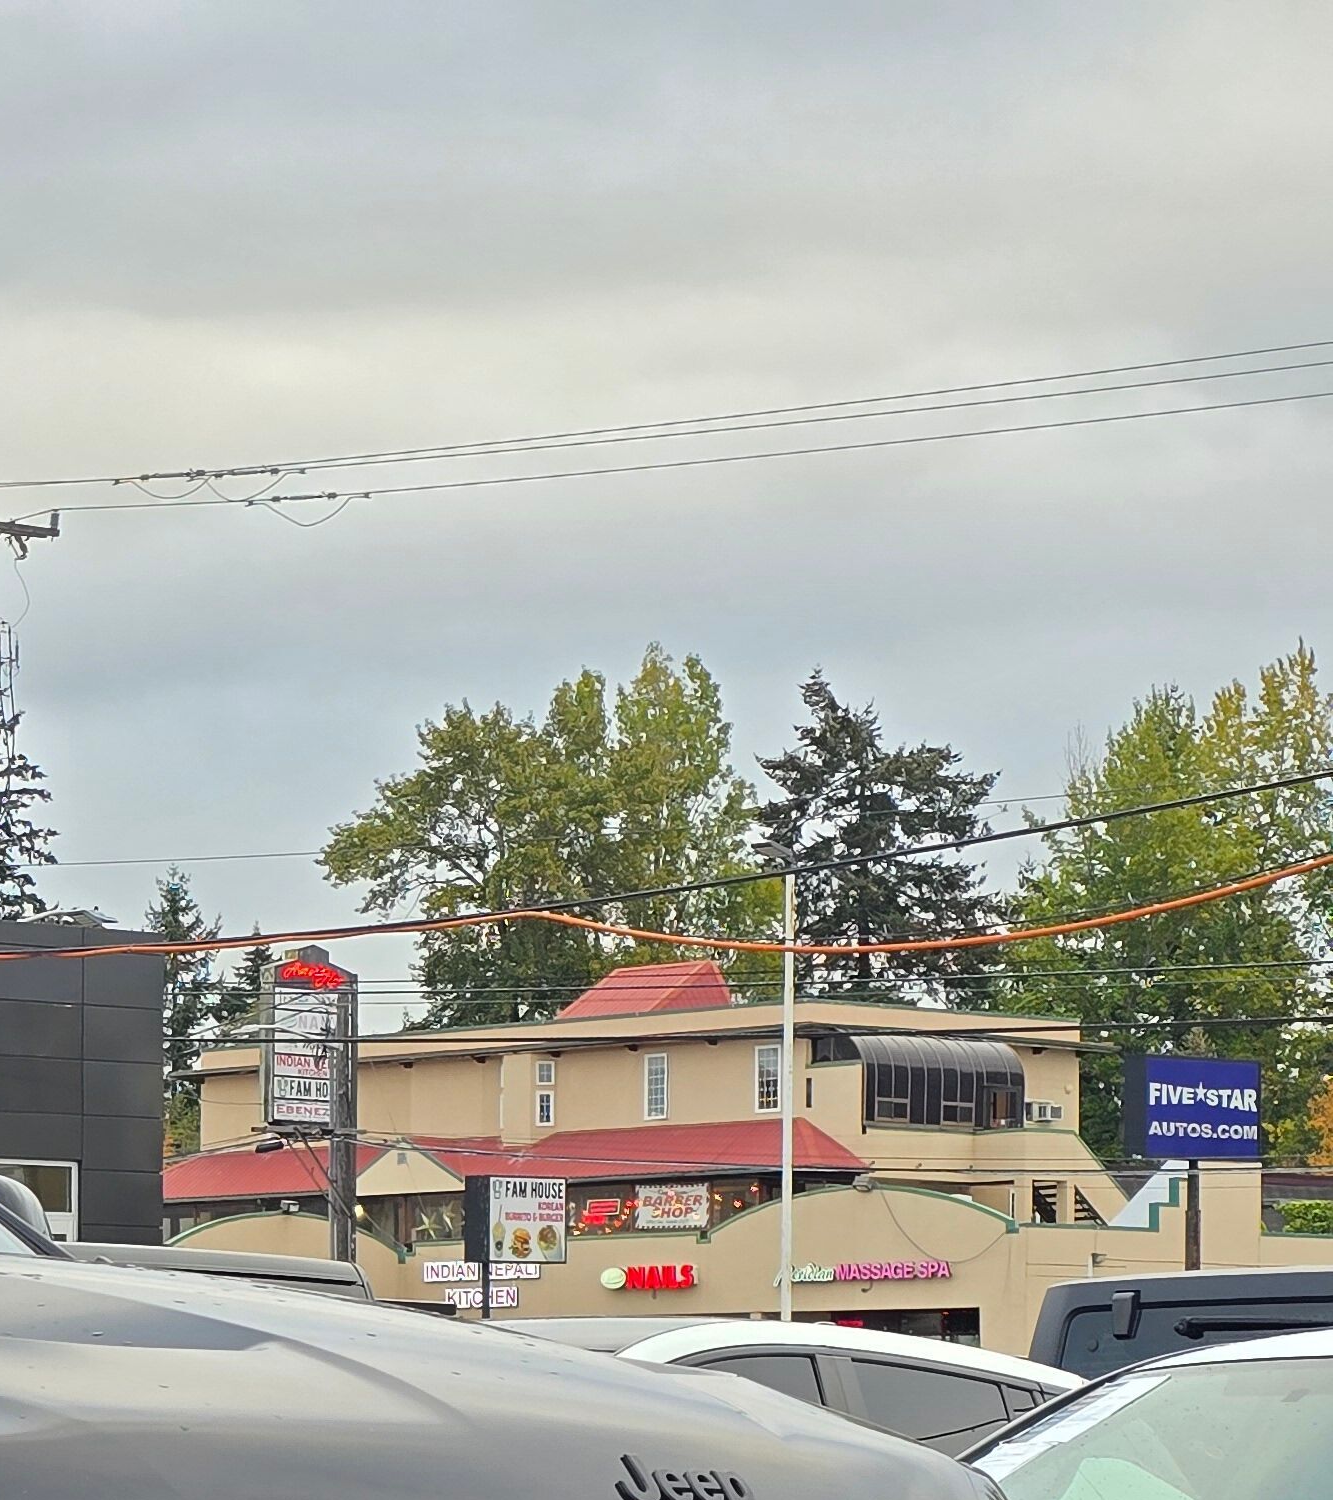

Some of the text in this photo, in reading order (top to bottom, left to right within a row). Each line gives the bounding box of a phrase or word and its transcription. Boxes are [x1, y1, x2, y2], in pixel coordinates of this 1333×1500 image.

[276, 1055, 311, 1068] INDIAN
[289, 1080, 330, 1099] FAM HO
[1149, 1082, 1258, 1113] FIVE STAR
[276, 1104, 330, 1117] EBENEZ
[1148, 1121, 1258, 1140] AUTOS.COM
[504, 1181, 564, 1200] FAM HOUSE
[642, 1194, 703, 1207] BARBER
[425, 1263, 476, 1279] INDIAN
[626, 1264, 695, 1290] NAILS
[835, 1263, 914, 1281] MASSAGE
[916, 1261, 952, 1279] SPA
